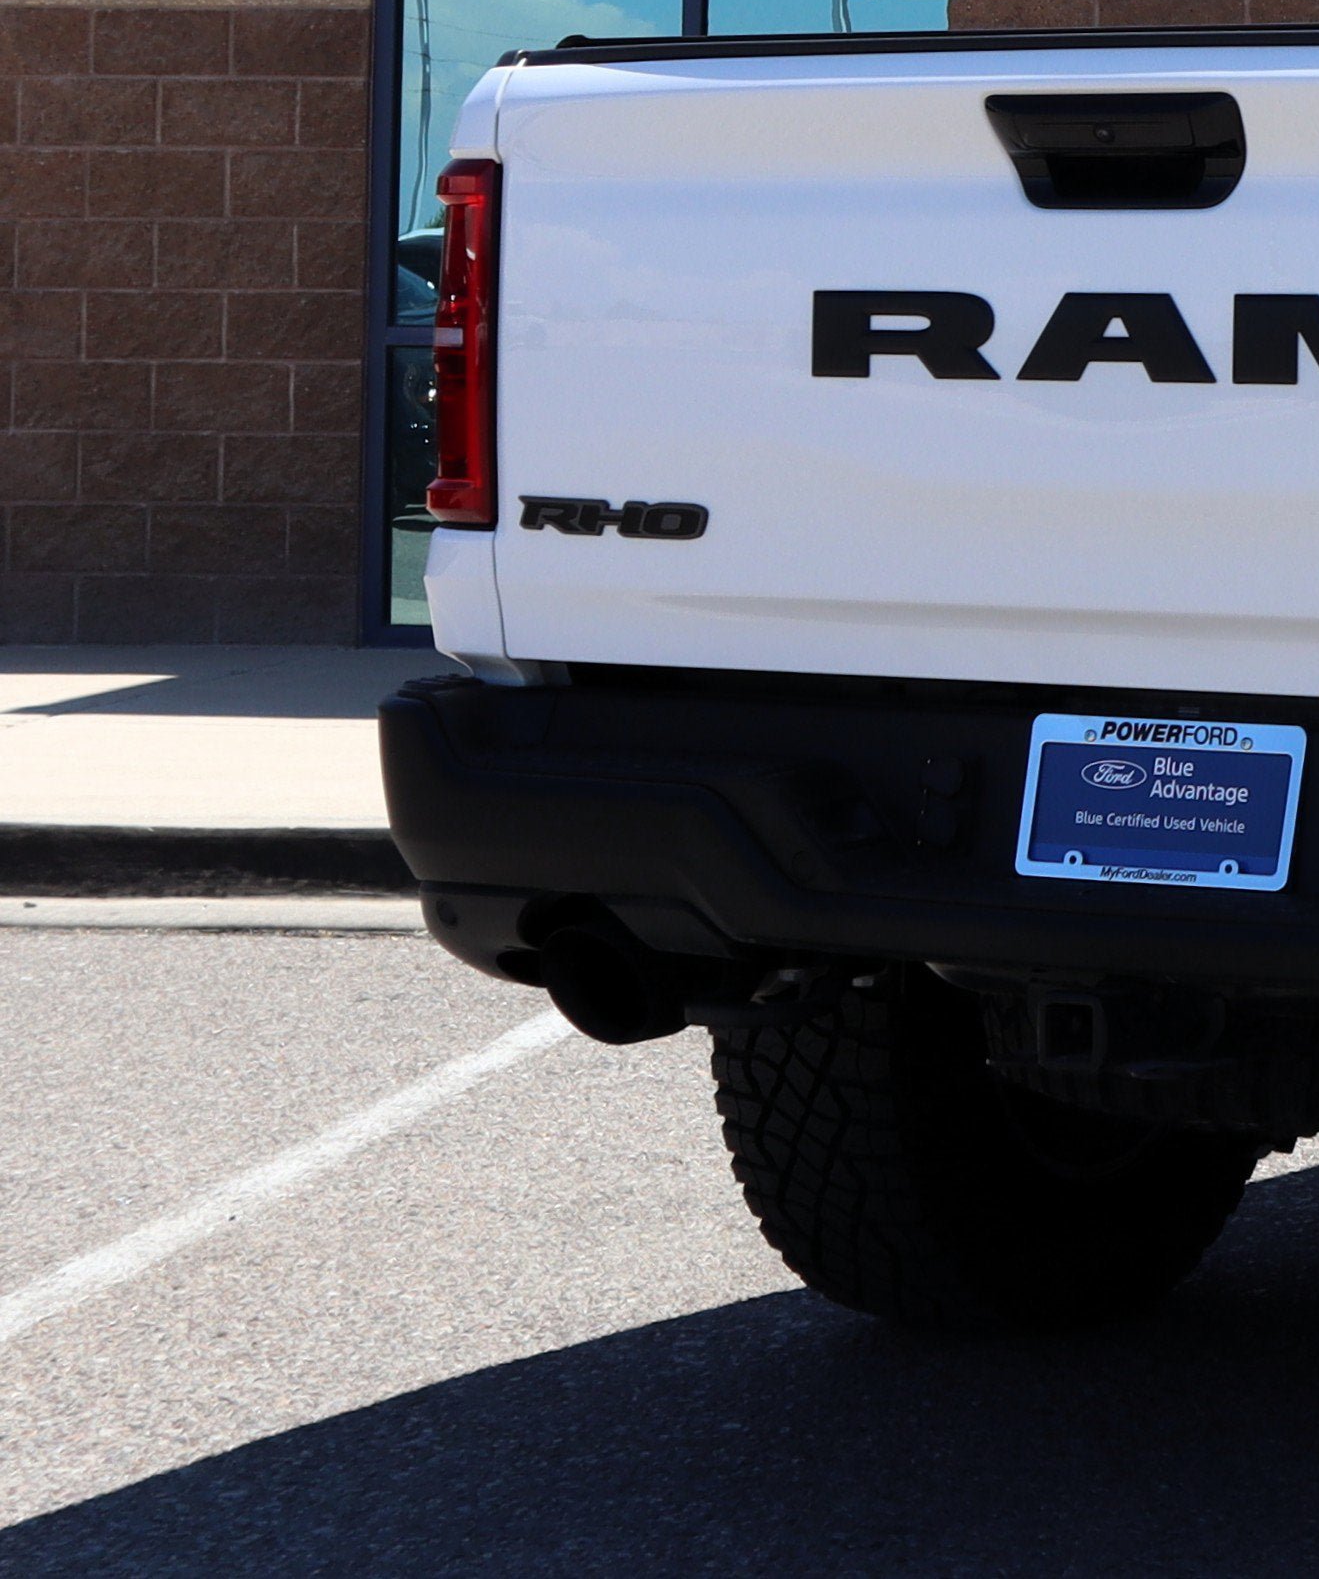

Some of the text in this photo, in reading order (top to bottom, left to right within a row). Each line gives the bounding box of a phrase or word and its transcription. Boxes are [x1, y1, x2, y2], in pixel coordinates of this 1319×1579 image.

[517, 495, 709, 540] RHO
[1093, 764, 1136, 786] Ford
[1152, 756, 1194, 777] Blue
[1149, 779, 1249, 806] Advantage
[1075, 810, 1246, 834] Blue Certified Used Vehicle
[1099, 866, 1197, 883] MyFordDealer.com
